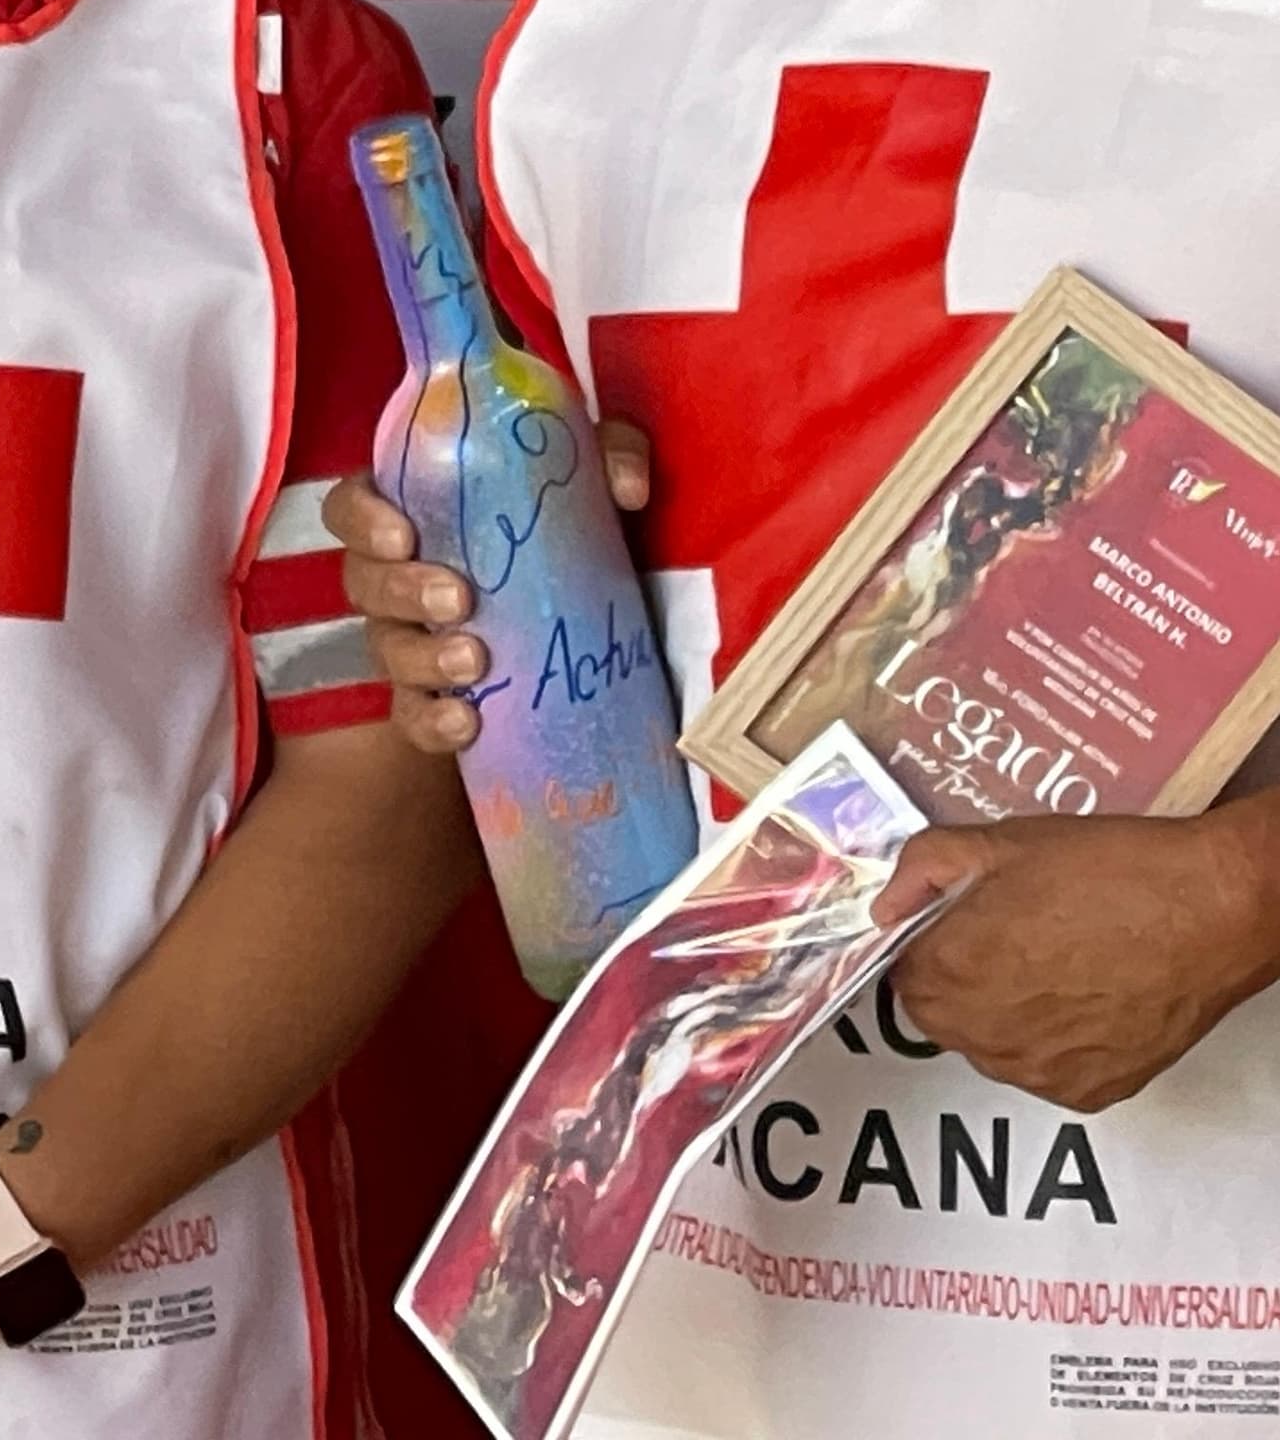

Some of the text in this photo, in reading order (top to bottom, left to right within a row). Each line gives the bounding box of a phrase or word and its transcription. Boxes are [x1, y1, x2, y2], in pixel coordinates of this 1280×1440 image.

[1088, 536, 1153, 588] MARCO
[1151, 582, 1233, 646] ANTONIO
[1092, 572, 1170, 635] BELTRÁN
[875, 639, 1097, 817] Legado
